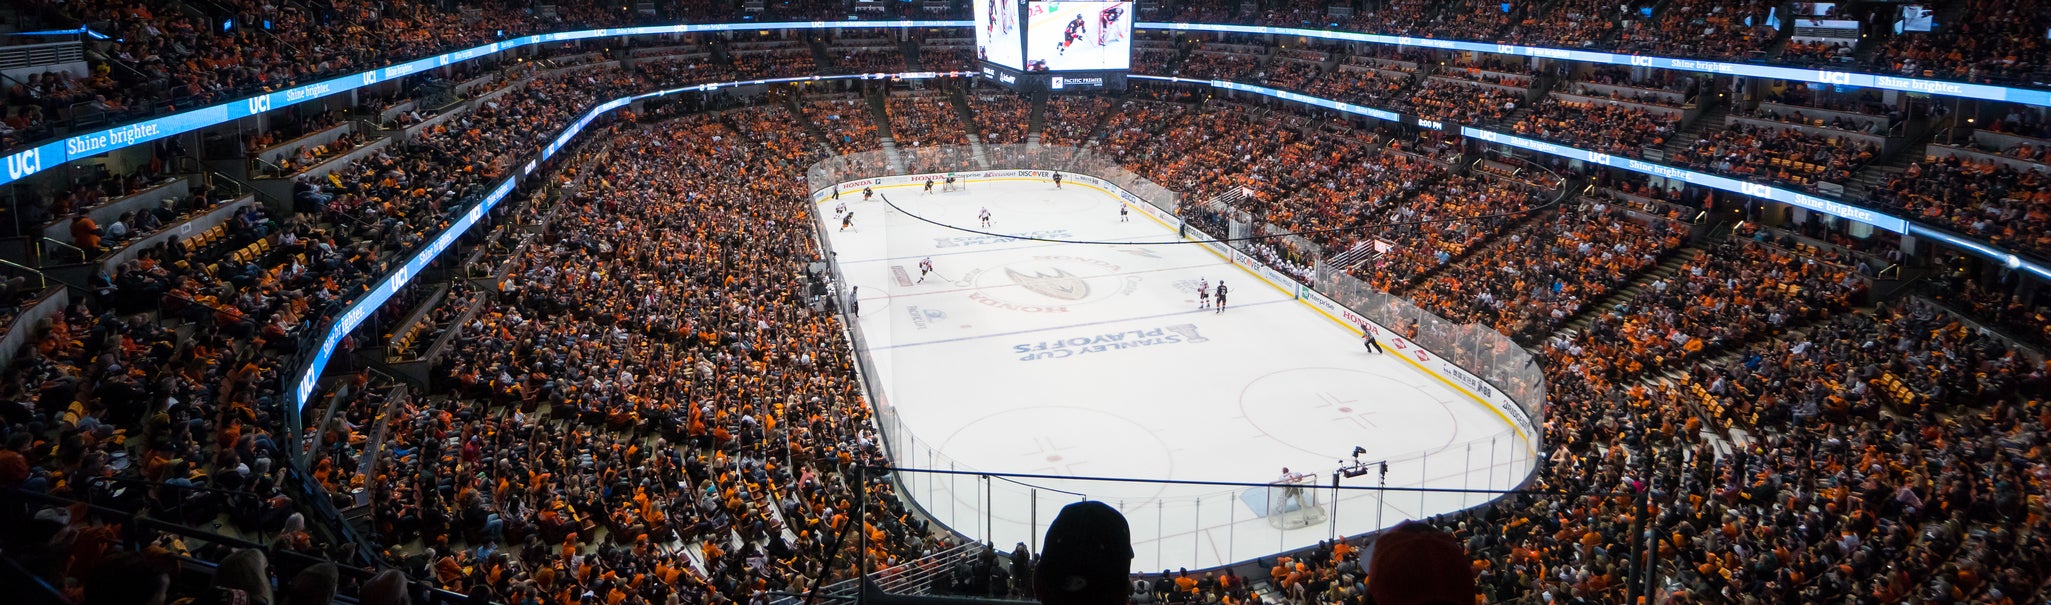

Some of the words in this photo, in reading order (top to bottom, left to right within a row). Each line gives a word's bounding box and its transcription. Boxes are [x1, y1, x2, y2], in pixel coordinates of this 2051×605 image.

[1498, 45, 1514, 54] UCI
[1631, 55, 1652, 67] UCI
[1671, 59, 1699, 69] Shine
[1701, 61, 1733, 72] brighter.
[363, 71, 376, 85] UCI
[1819, 70, 1850, 85] UCI
[1878, 76, 1909, 89] Shine
[1911, 79, 1963, 94] brighter.
[286, 88, 304, 101] Shine
[305, 83, 330, 97] brighter.
[249, 94, 270, 114] UCI
[1418, 118, 1432, 128] 8:00
[1433, 121, 1442, 130] PM
[67, 135, 107, 155] Shine
[109, 123, 160, 144] brighter.
[1480, 129, 1497, 142] UCI
[1511, 136, 1529, 147] Shine
[7, 147, 41, 180] UCI
[1588, 152, 1610, 166] UCI
[911, 174, 945, 182] HONDA
[1018, 170, 1049, 178] DISCOVER
[1629, 159, 1652, 174] Shine
[1654, 164, 1692, 181] brighter.
[843, 180, 873, 189] HONDA
[1741, 181, 1771, 199] UCI
[469, 204, 481, 224] UCI
[1795, 194, 1824, 210] Shine
[1826, 201, 1873, 222] brighter.
[419, 245, 433, 265] Shine
[1236, 252, 1260, 272] DISCOVER
[391, 265, 408, 292] UCI
[969, 292, 1070, 313] HONDA
[1343, 310, 1379, 336] HONDA
[323, 333, 335, 358] Shine
[1013, 327, 1165, 353] PLAYOFFS
[1080, 335, 1182, 355] STANLEY
[1019, 349, 1074, 362] CUP
[300, 363, 315, 403] UCI
